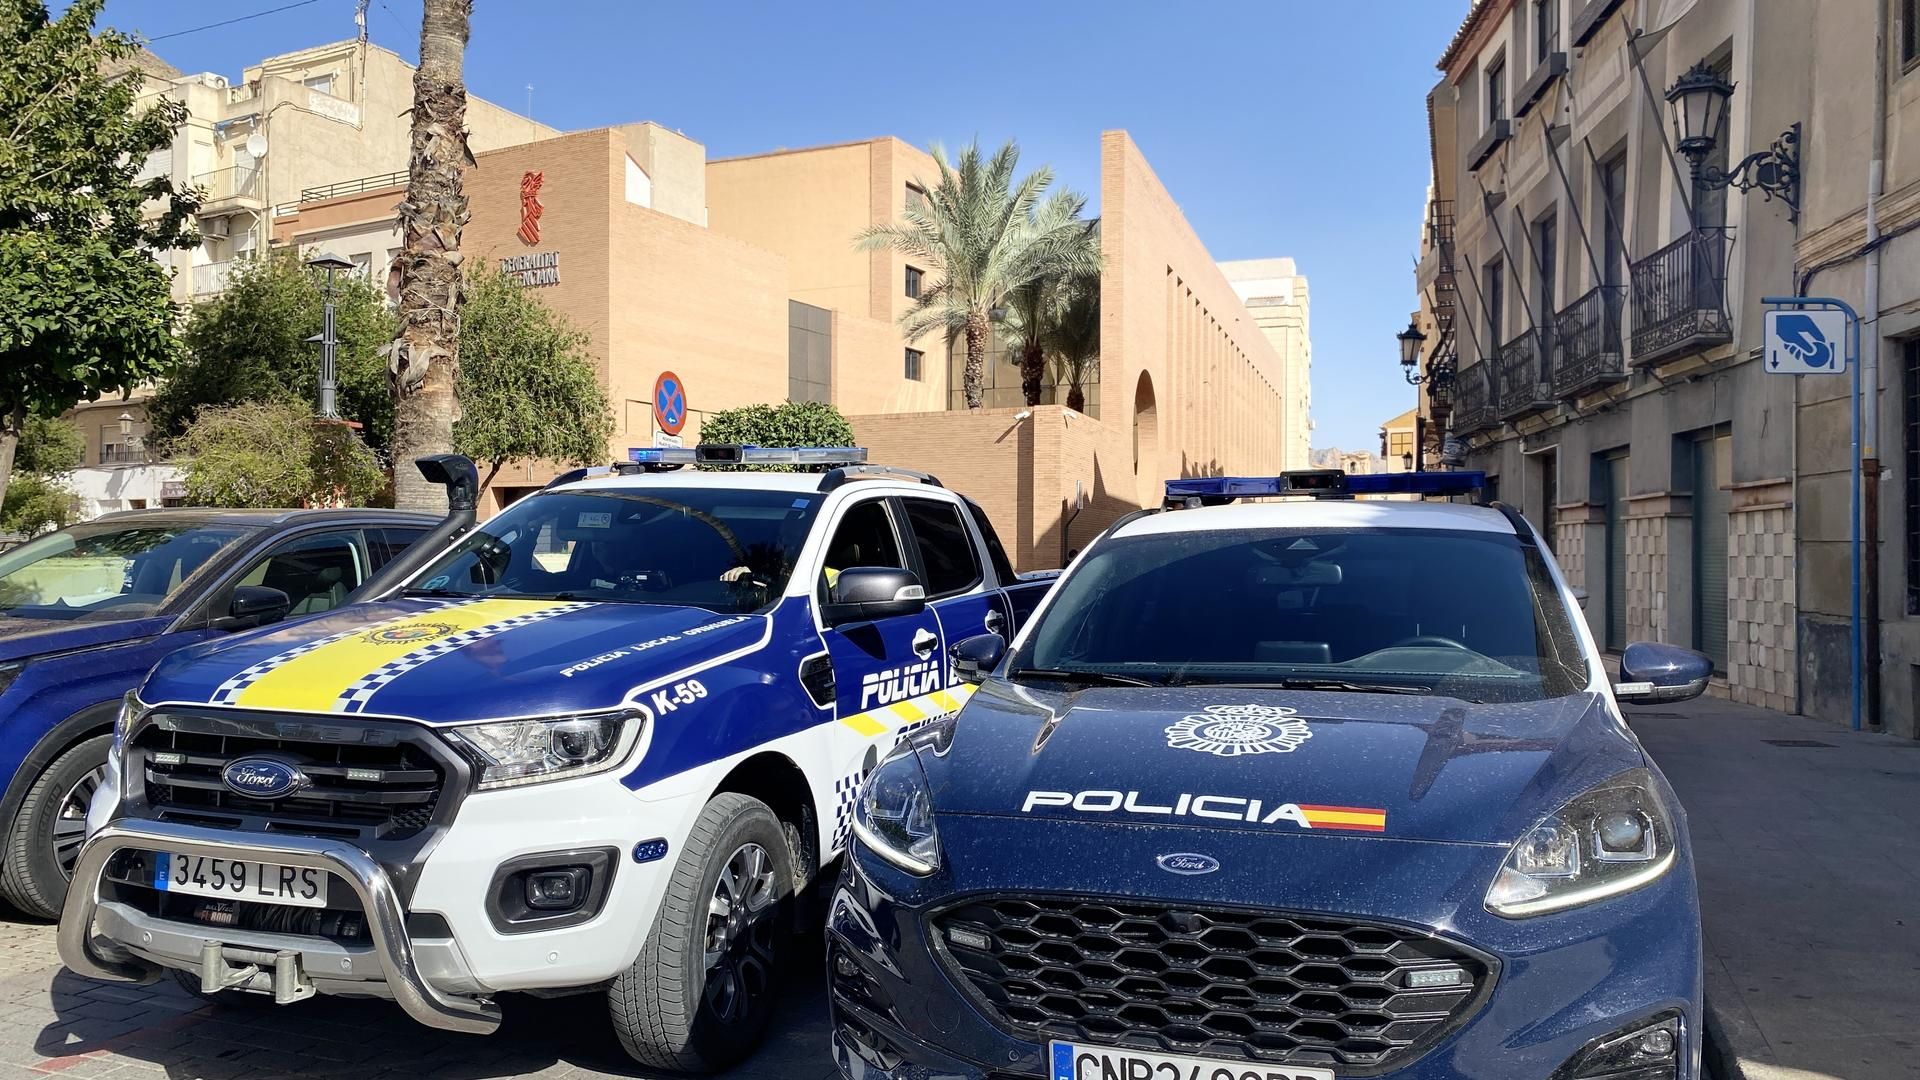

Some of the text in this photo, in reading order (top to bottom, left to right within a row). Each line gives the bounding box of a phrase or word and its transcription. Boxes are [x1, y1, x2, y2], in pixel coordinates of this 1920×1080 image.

[560, 651, 631, 678] POLICIA
[631, 635, 682, 651] LOCAL
[651, 680, 708, 715] K-59
[861, 660, 940, 710] POLICIA
[236, 765, 278, 788] Ford
[1021, 790, 1312, 829] POLICIA
[159, 854, 318, 900] E 3459 LRS
[1171, 856, 1206, 870] Ford
